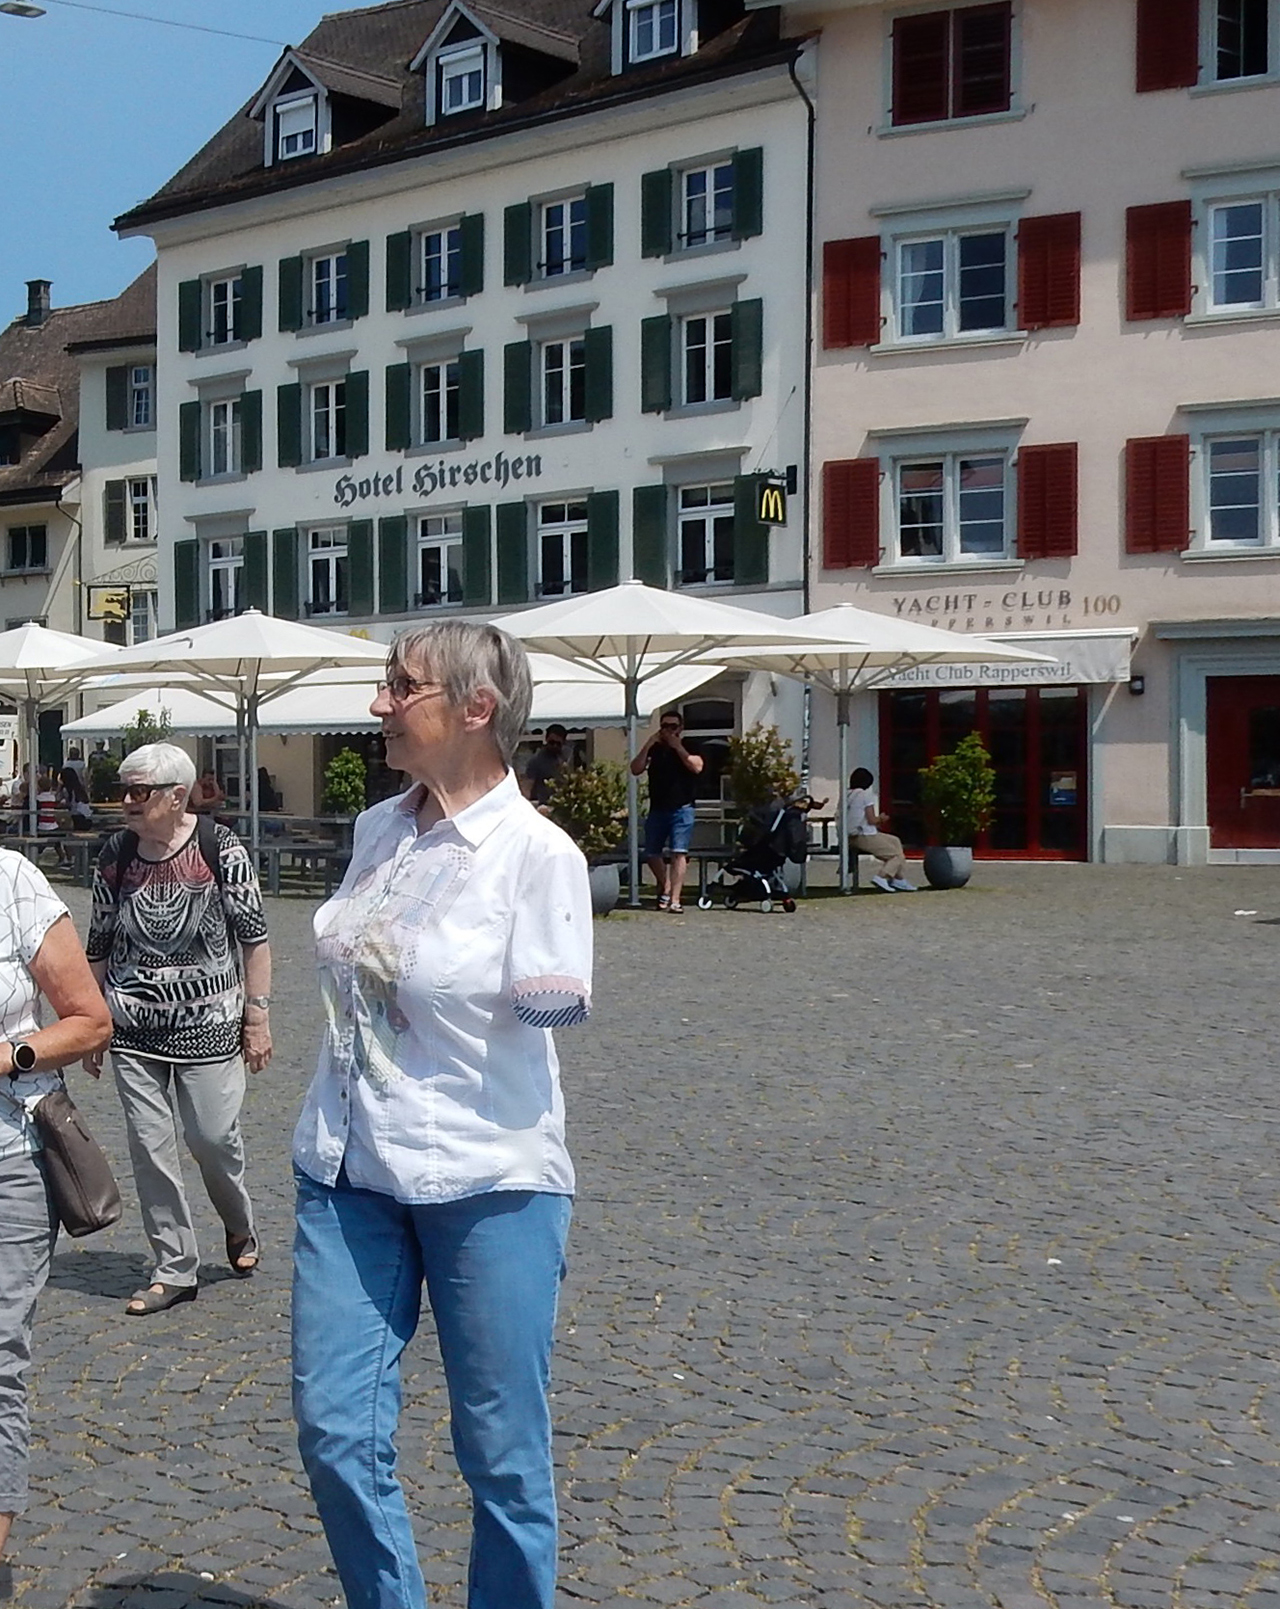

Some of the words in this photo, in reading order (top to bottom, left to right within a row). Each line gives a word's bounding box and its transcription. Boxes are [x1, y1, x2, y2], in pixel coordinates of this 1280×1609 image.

[334, 465, 403, 508] Hotel
[412, 450, 542, 498] Hirschen
[893, 593, 977, 614] YACHT
[1001, 590, 1072, 610] CLUB
[1082, 595, 1121, 616] 100
[935, 664, 973, 681] Club
[979, 662, 1071, 682] Rapperswil
